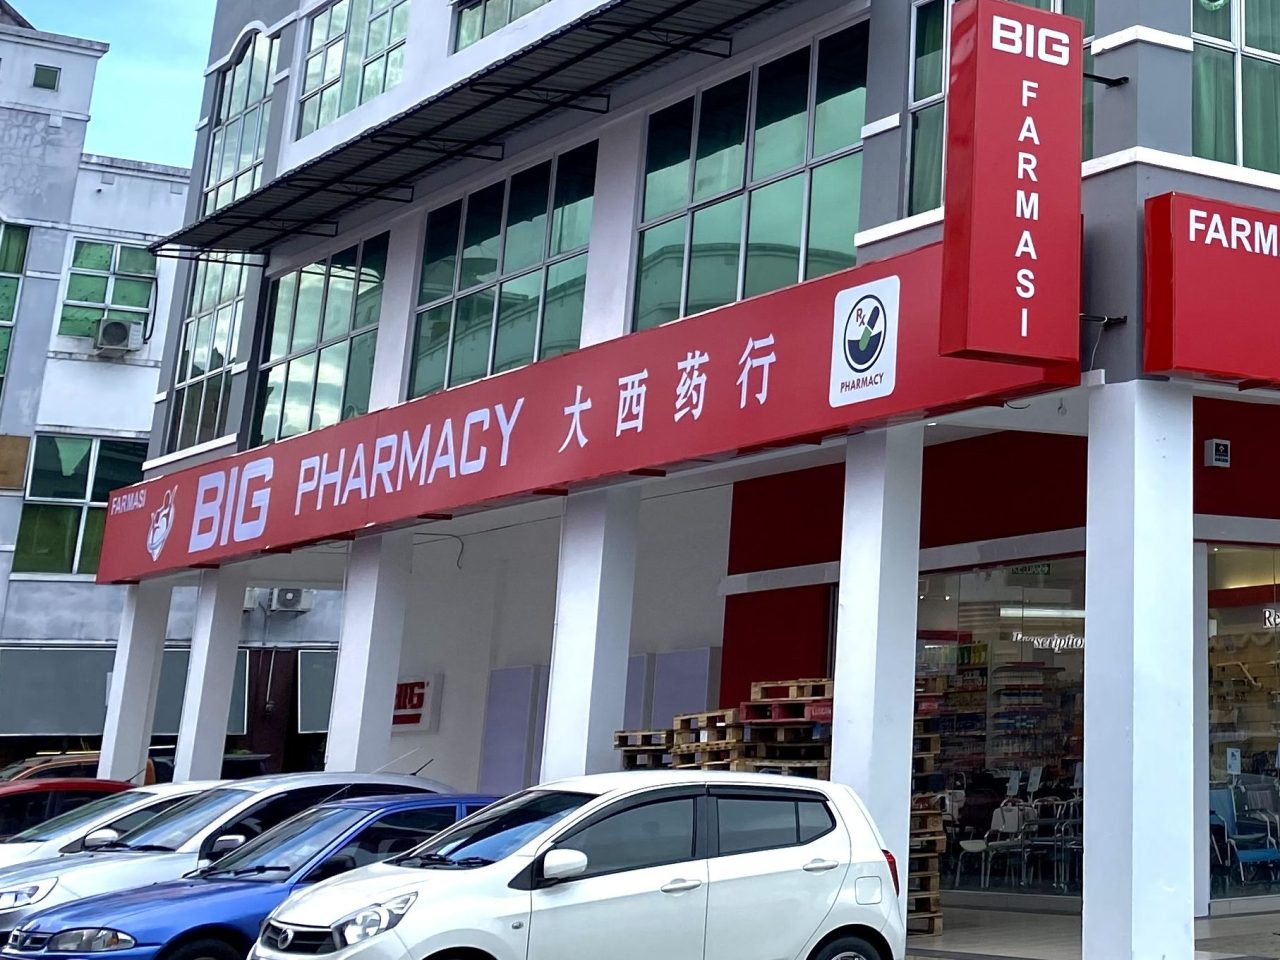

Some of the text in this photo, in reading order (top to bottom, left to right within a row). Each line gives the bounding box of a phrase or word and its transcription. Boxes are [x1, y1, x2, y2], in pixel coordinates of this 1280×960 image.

[992, 15, 1070, 66] BIG
[1014, 79, 1040, 337] FARMASI
[840, 373, 884, 393] PHARMACY
[188, 333, 777, 554] BIG PHARMACY 大西药行
[111, 489, 147, 515] FARMASI
